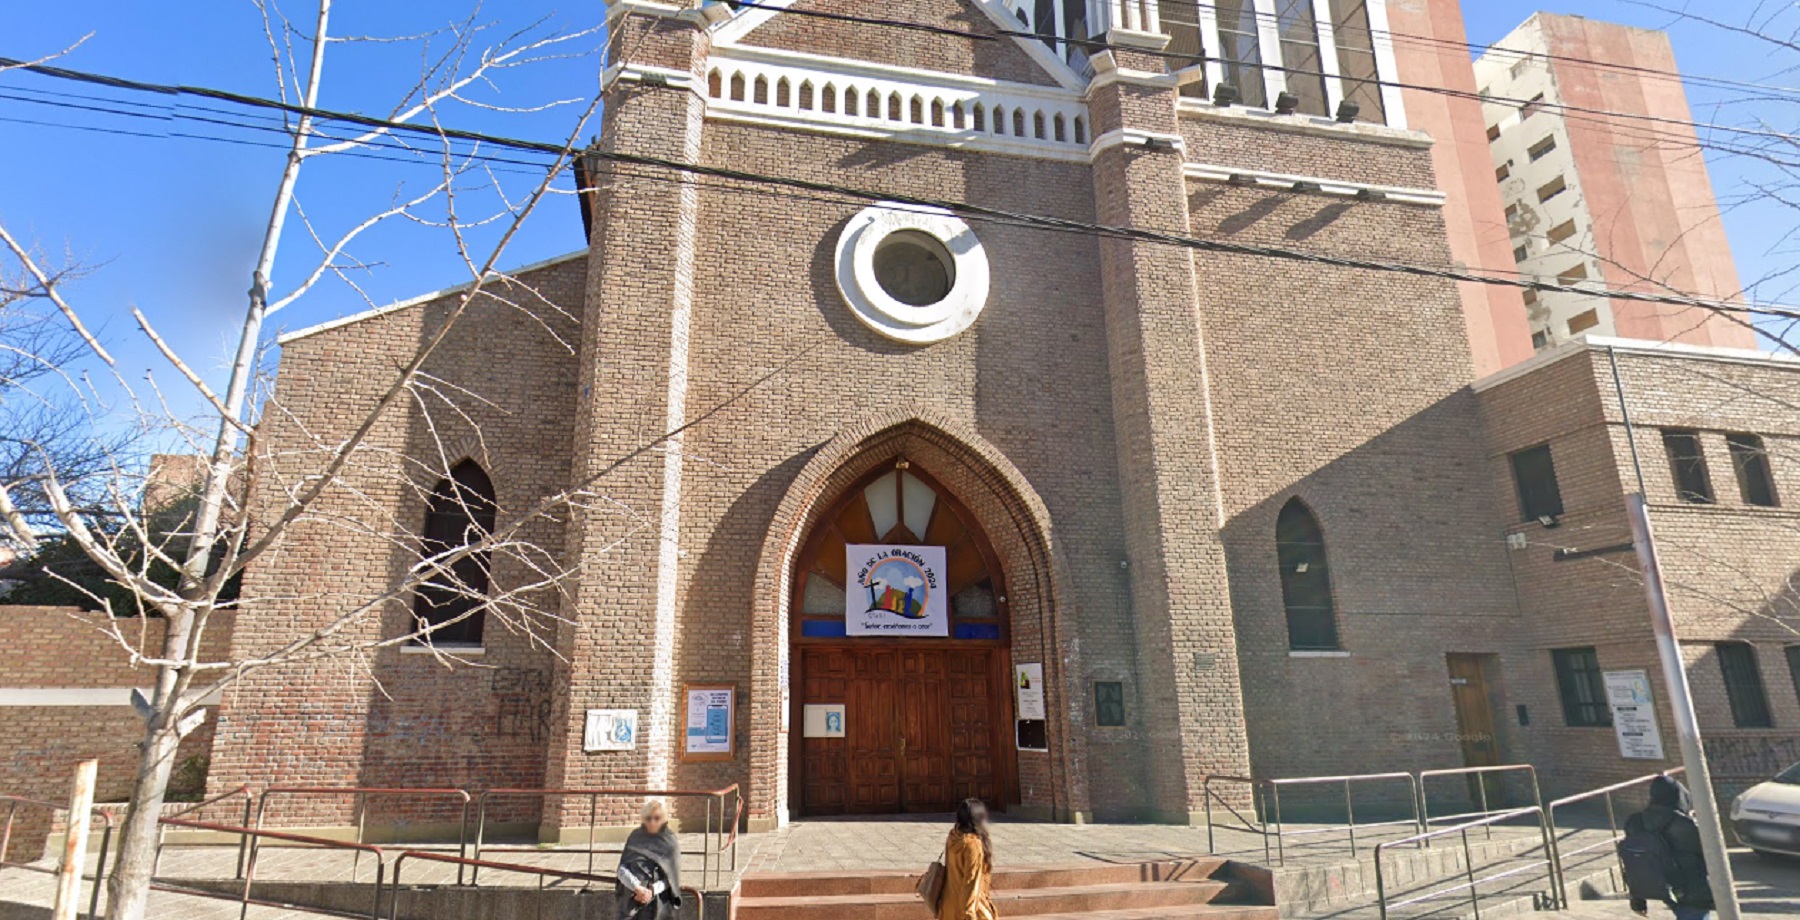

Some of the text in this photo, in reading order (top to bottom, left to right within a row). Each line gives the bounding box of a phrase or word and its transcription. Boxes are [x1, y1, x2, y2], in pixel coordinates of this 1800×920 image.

[858, 567, 869, 586] AÑO
[866, 557, 877, 567] DE
[877, 551, 888, 560] LA
[891, 548, 925, 567] ORACIÓN
